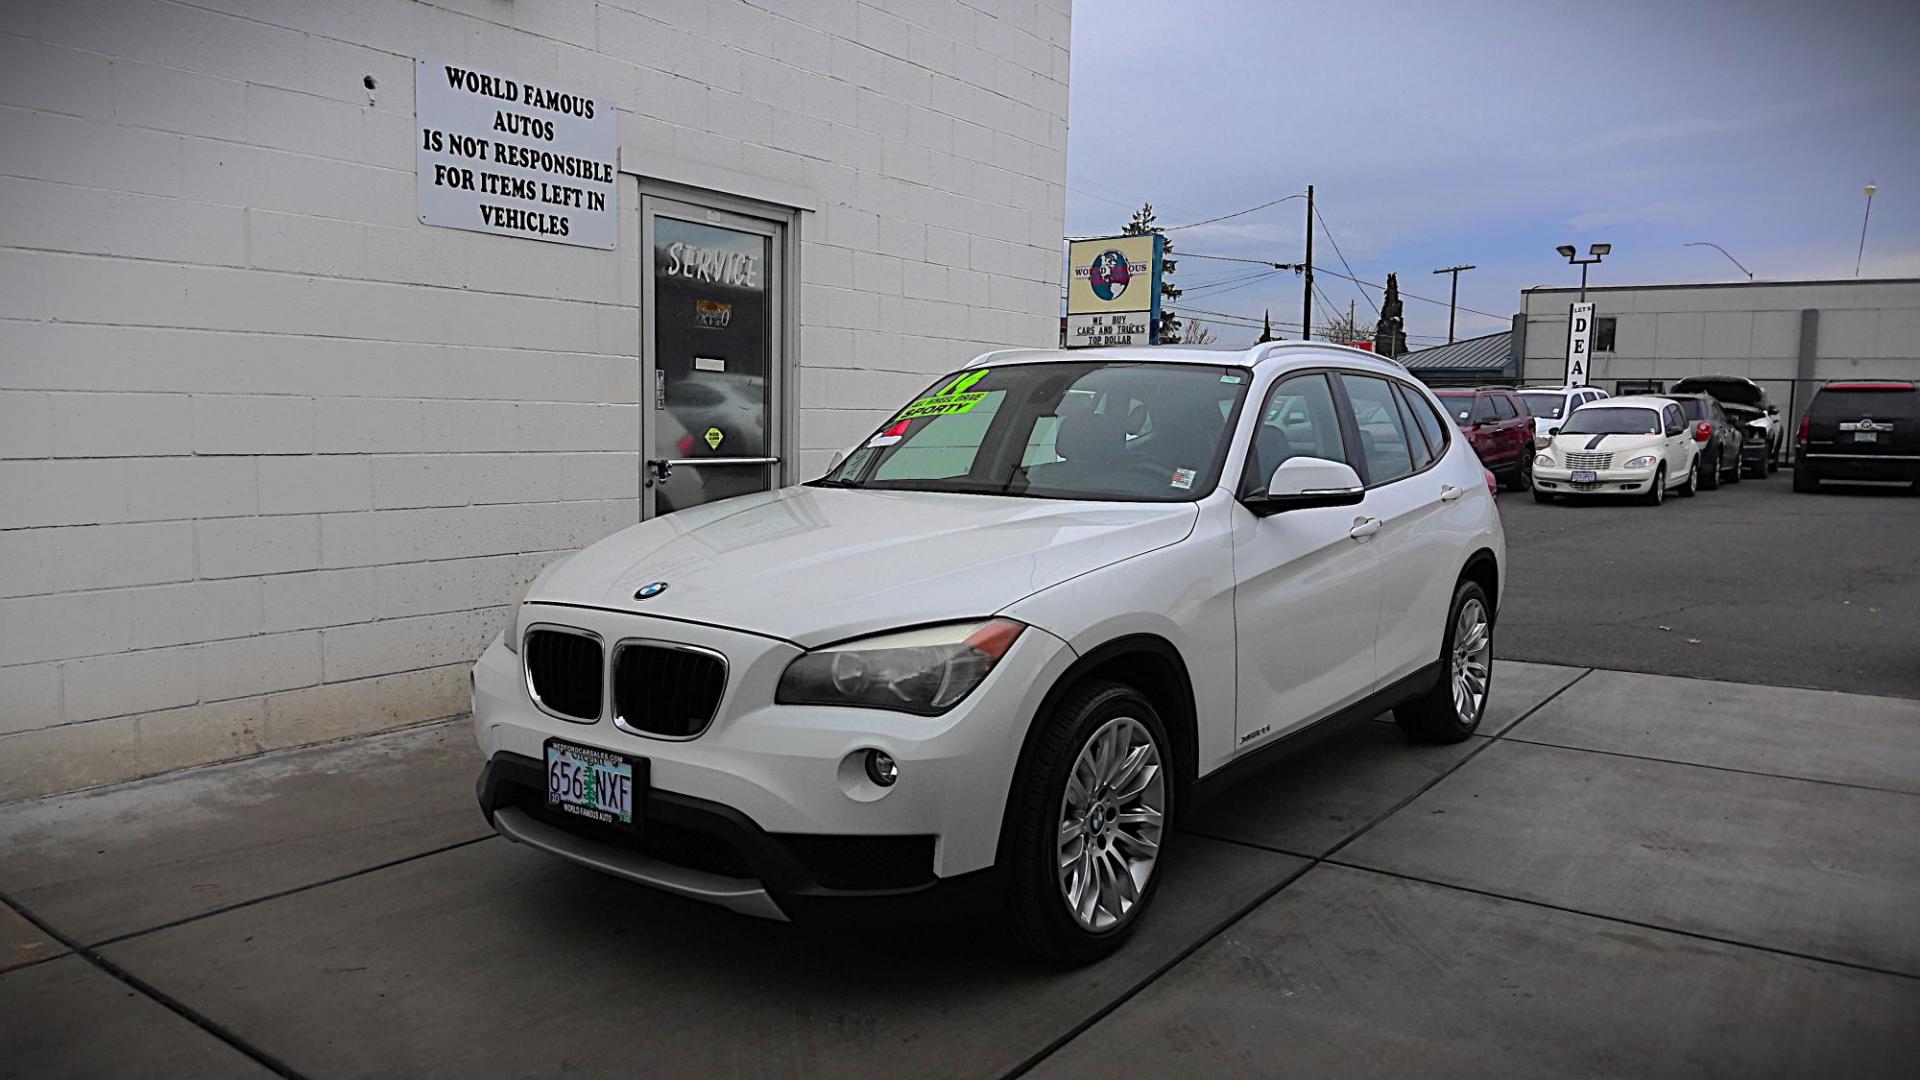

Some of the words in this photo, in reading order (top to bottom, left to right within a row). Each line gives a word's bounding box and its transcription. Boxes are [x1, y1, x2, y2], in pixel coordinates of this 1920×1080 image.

[445, 65, 518, 101] WORLD
[523, 84, 594, 119] FAMOUS
[493, 110, 554, 141] AUTOS
[423, 128, 443, 152] IS
[449, 133, 489, 160] NOT
[494, 142, 613, 184] RESPONSIBLE
[434, 164, 475, 191] FOR
[480, 171, 537, 201] ITEMS
[541, 182, 583, 209] LEFT
[587, 190, 605, 212] IN
[479, 203, 569, 237] VEHICLES
[667, 241, 758, 287] SERVICE
[1077, 326, 1095, 336] CARS
[1098, 325, 1113, 335] AND
[1117, 324, 1145, 334] TRUCKS
[1092, 316, 1103, 325] WE
[1112, 315, 1126, 324] BUY
[1088, 336, 1102, 345] TOP
[1104, 335, 1132, 344] DOLLAR
[1571, 318, 1587, 386] DEA
[905, 403, 971, 416] SPORTY
[550, 759, 583, 800] 656
[595, 769, 631, 809] NXF
[563, 803, 580, 814] WORLD
[580, 806, 599, 819] FAMOUS
